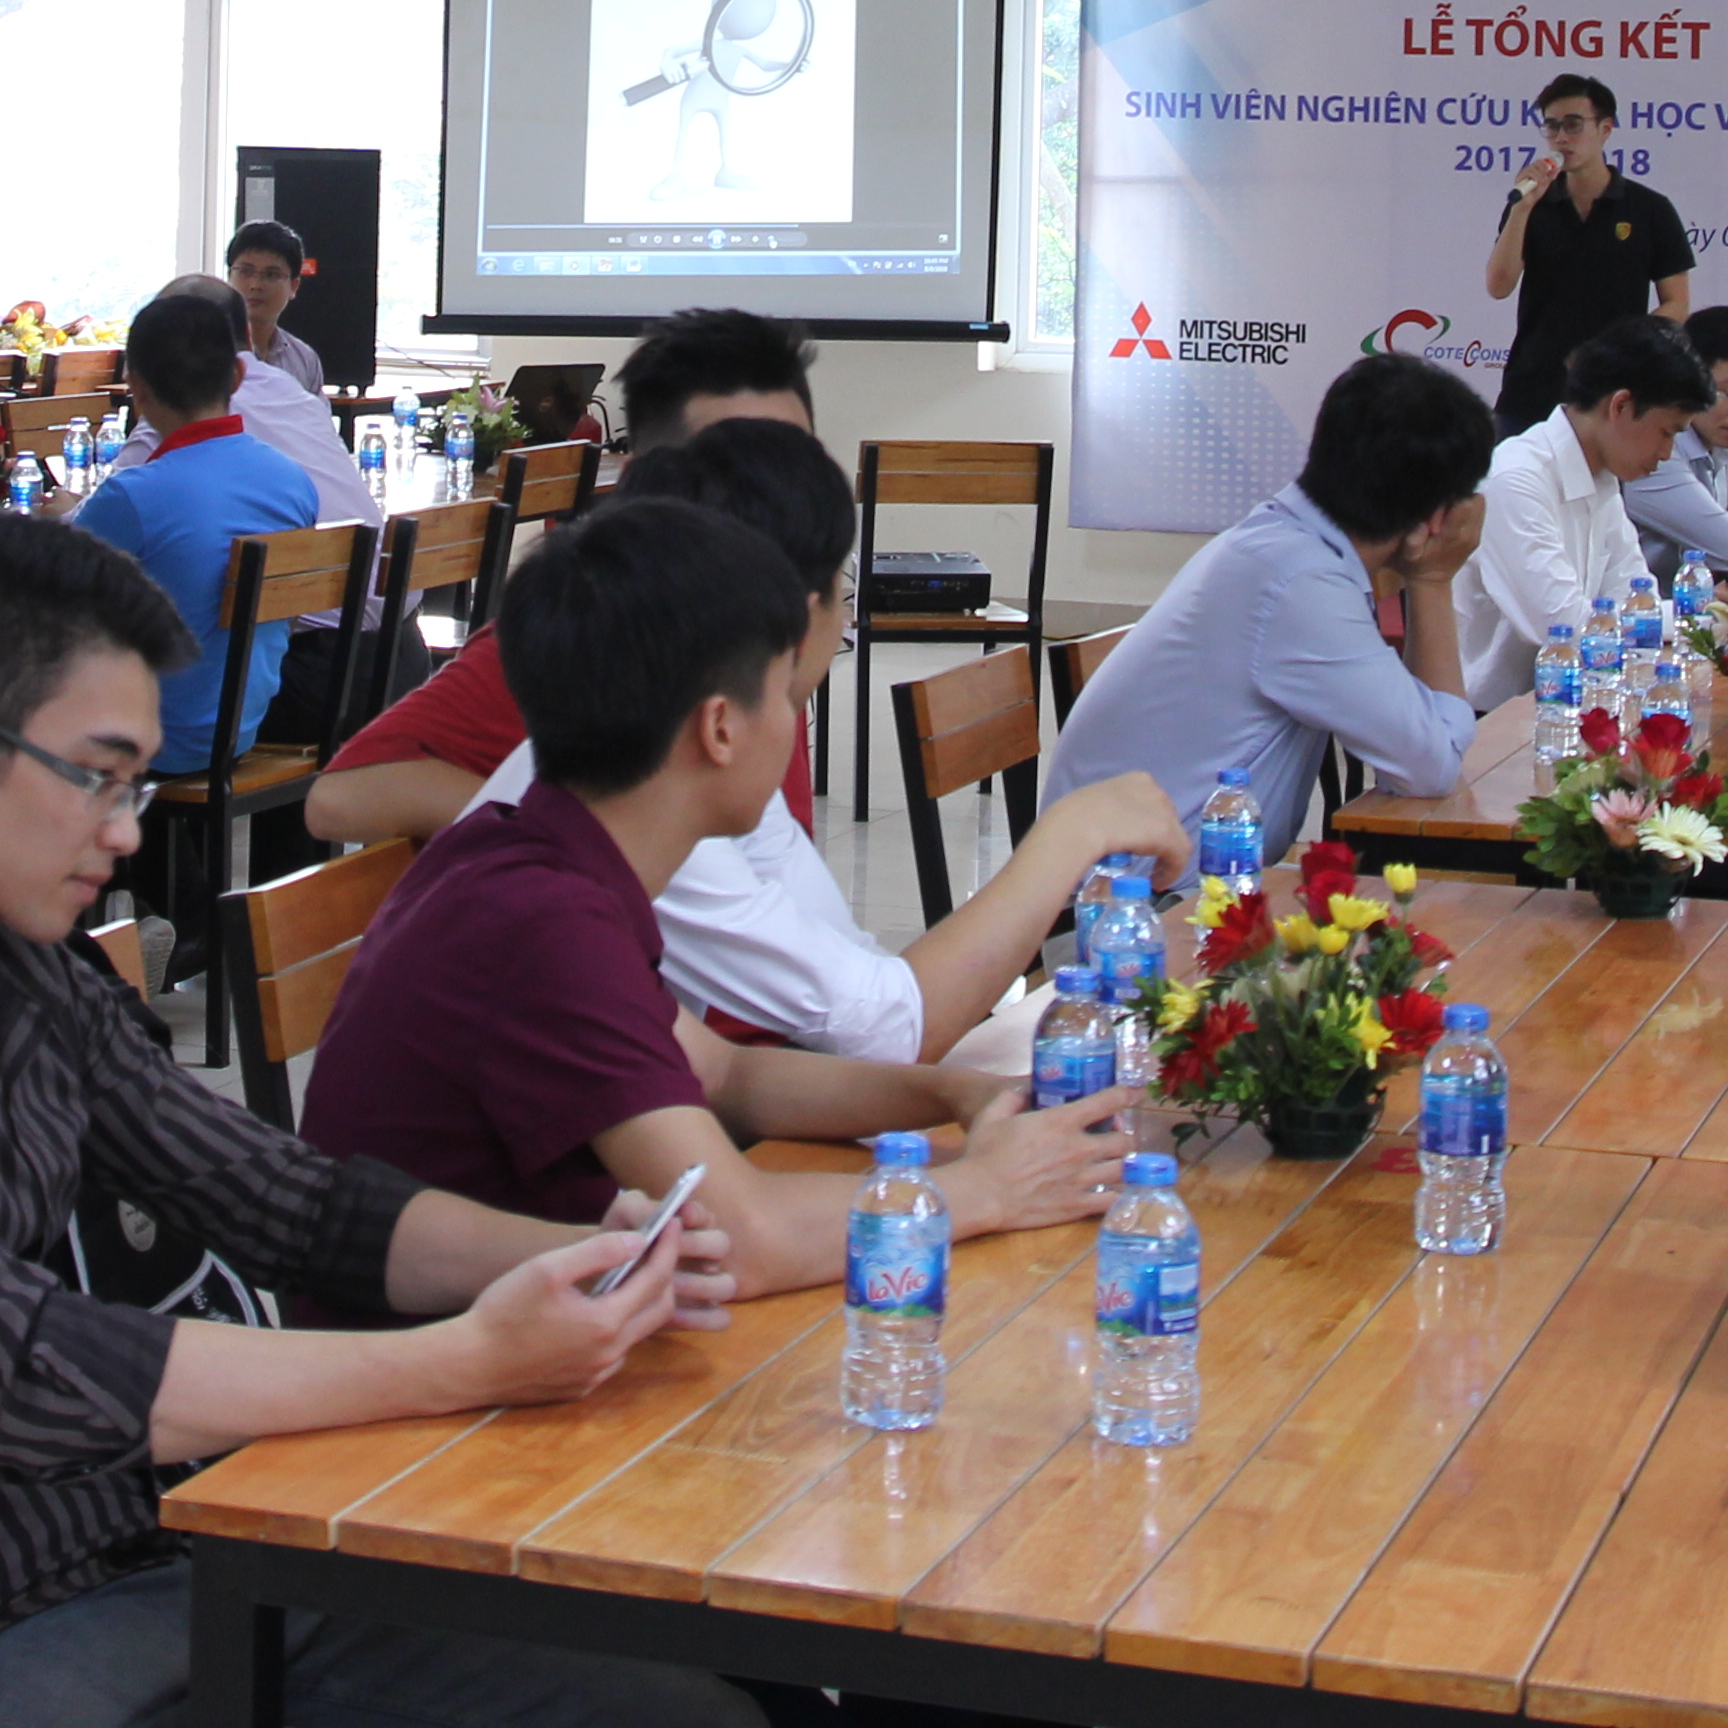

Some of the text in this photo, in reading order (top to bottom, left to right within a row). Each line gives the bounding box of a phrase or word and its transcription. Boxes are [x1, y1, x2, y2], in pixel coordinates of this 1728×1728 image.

[1403, 3, 1711, 61] LỄ TỔNG KẾT
[1124, 91, 1203, 119] SINH
[1211, 88, 1287, 121] VIÊN
[1297, 92, 1426, 125] NGHIÊN
[1436, 93, 1511, 127] CỨU
[1630, 101, 1707, 138] HỌC
[1455, 145, 1538, 172] 2017
[1179, 320, 1307, 344] MITSUBISHI
[1179, 341, 1289, 365] ELECTRIC
